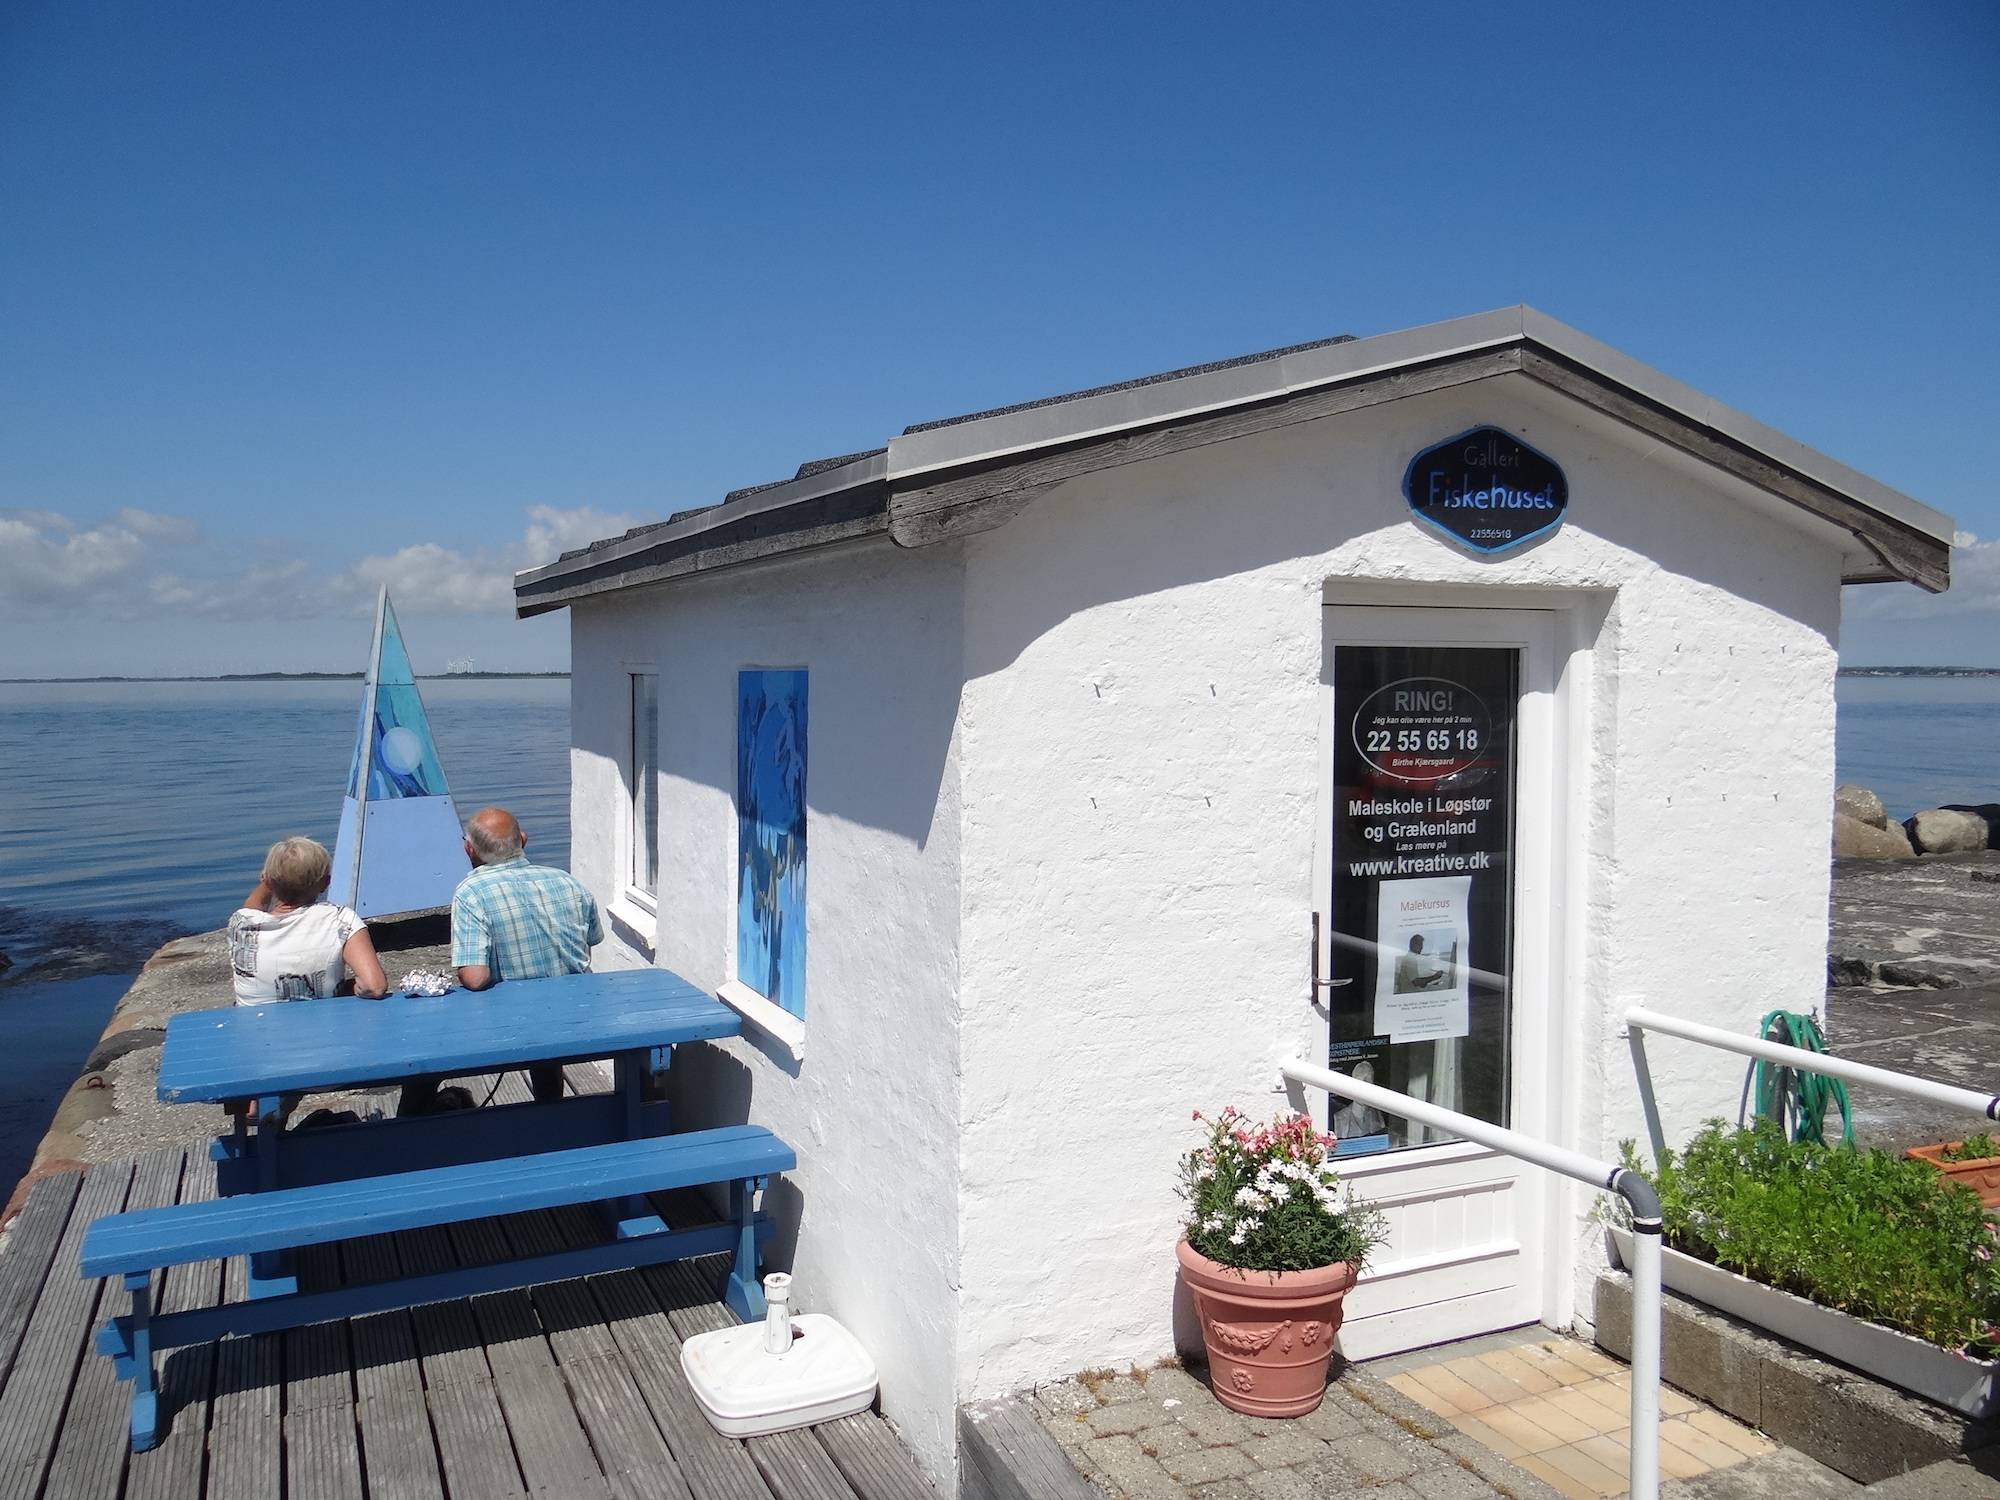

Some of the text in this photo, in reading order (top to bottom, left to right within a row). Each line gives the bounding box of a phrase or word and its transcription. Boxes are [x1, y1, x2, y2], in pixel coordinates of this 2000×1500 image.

[1464, 440, 1519, 468] Galleri
[1429, 471, 1554, 510] Fiskehuset
[1470, 528, 1512, 540] 22556518
[1394, 690, 1453, 712] RING!
[1372, 716, 1385, 726] Jeg
[1386, 716, 1399, 724] kan
[1432, 716, 1443, 724] her
[1444, 716, 1454, 726] på
[1454, 716, 1459, 724] 2
[1459, 716, 1472, 724] min
[1366, 729, 1478, 752] 22 55 65 18
[1392, 757, 1454, 768] Birthe Kjærsgaard
[1349, 796, 1492, 816] Maleskole i Løgstør
[1364, 818, 1477, 842] og Grækenland
[1396, 840, 1447, 851] Læs mere på
[1349, 851, 1490, 877] www.kreative.dk
[1400, 898, 1451, 912] Malekursus
